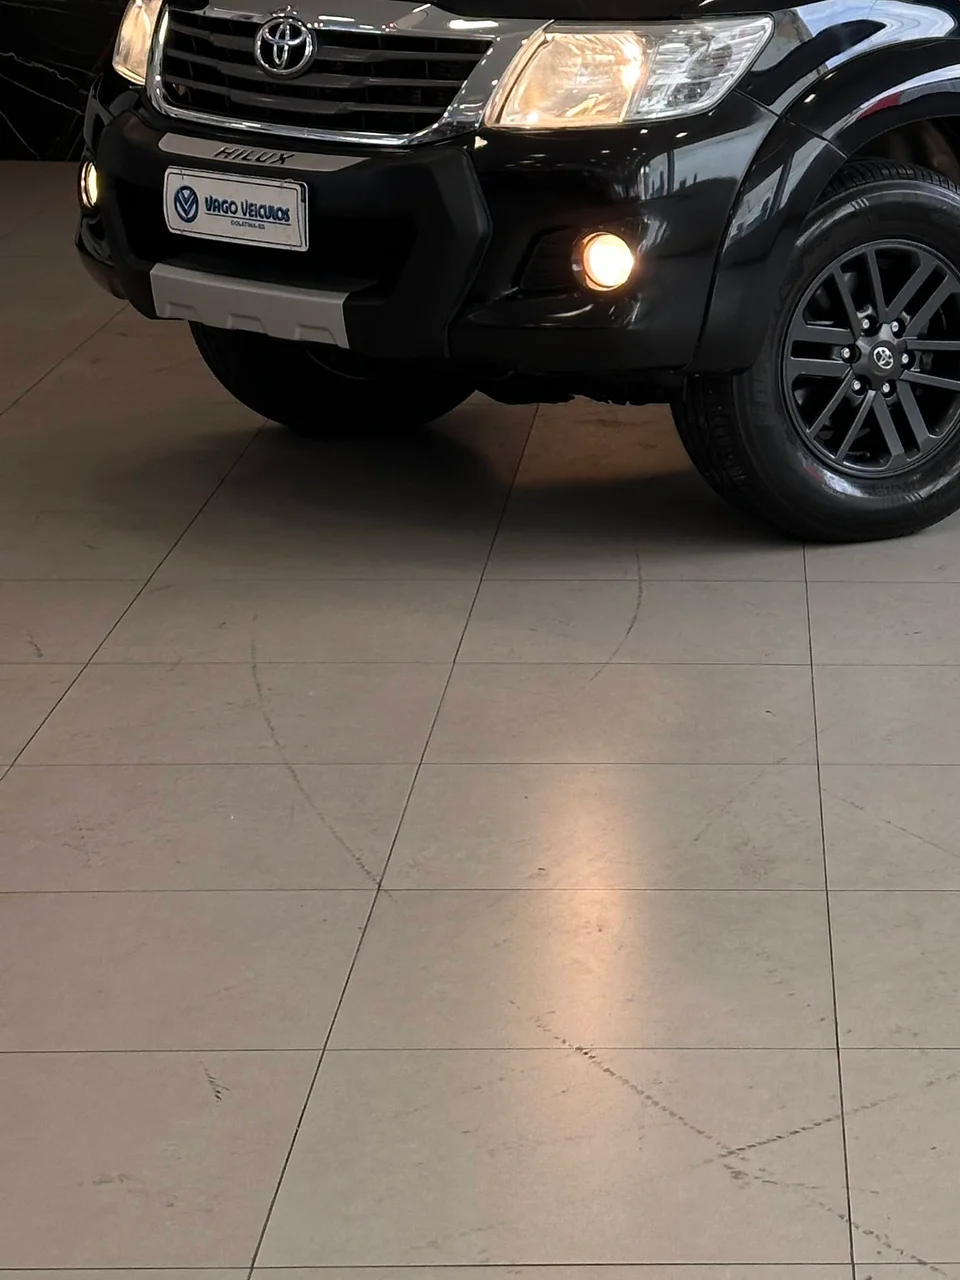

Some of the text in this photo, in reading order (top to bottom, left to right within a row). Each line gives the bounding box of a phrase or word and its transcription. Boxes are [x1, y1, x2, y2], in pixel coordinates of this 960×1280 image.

[214, 146, 295, 165] HILUX
[204, 194, 290, 222] VAGO VEICULOS
